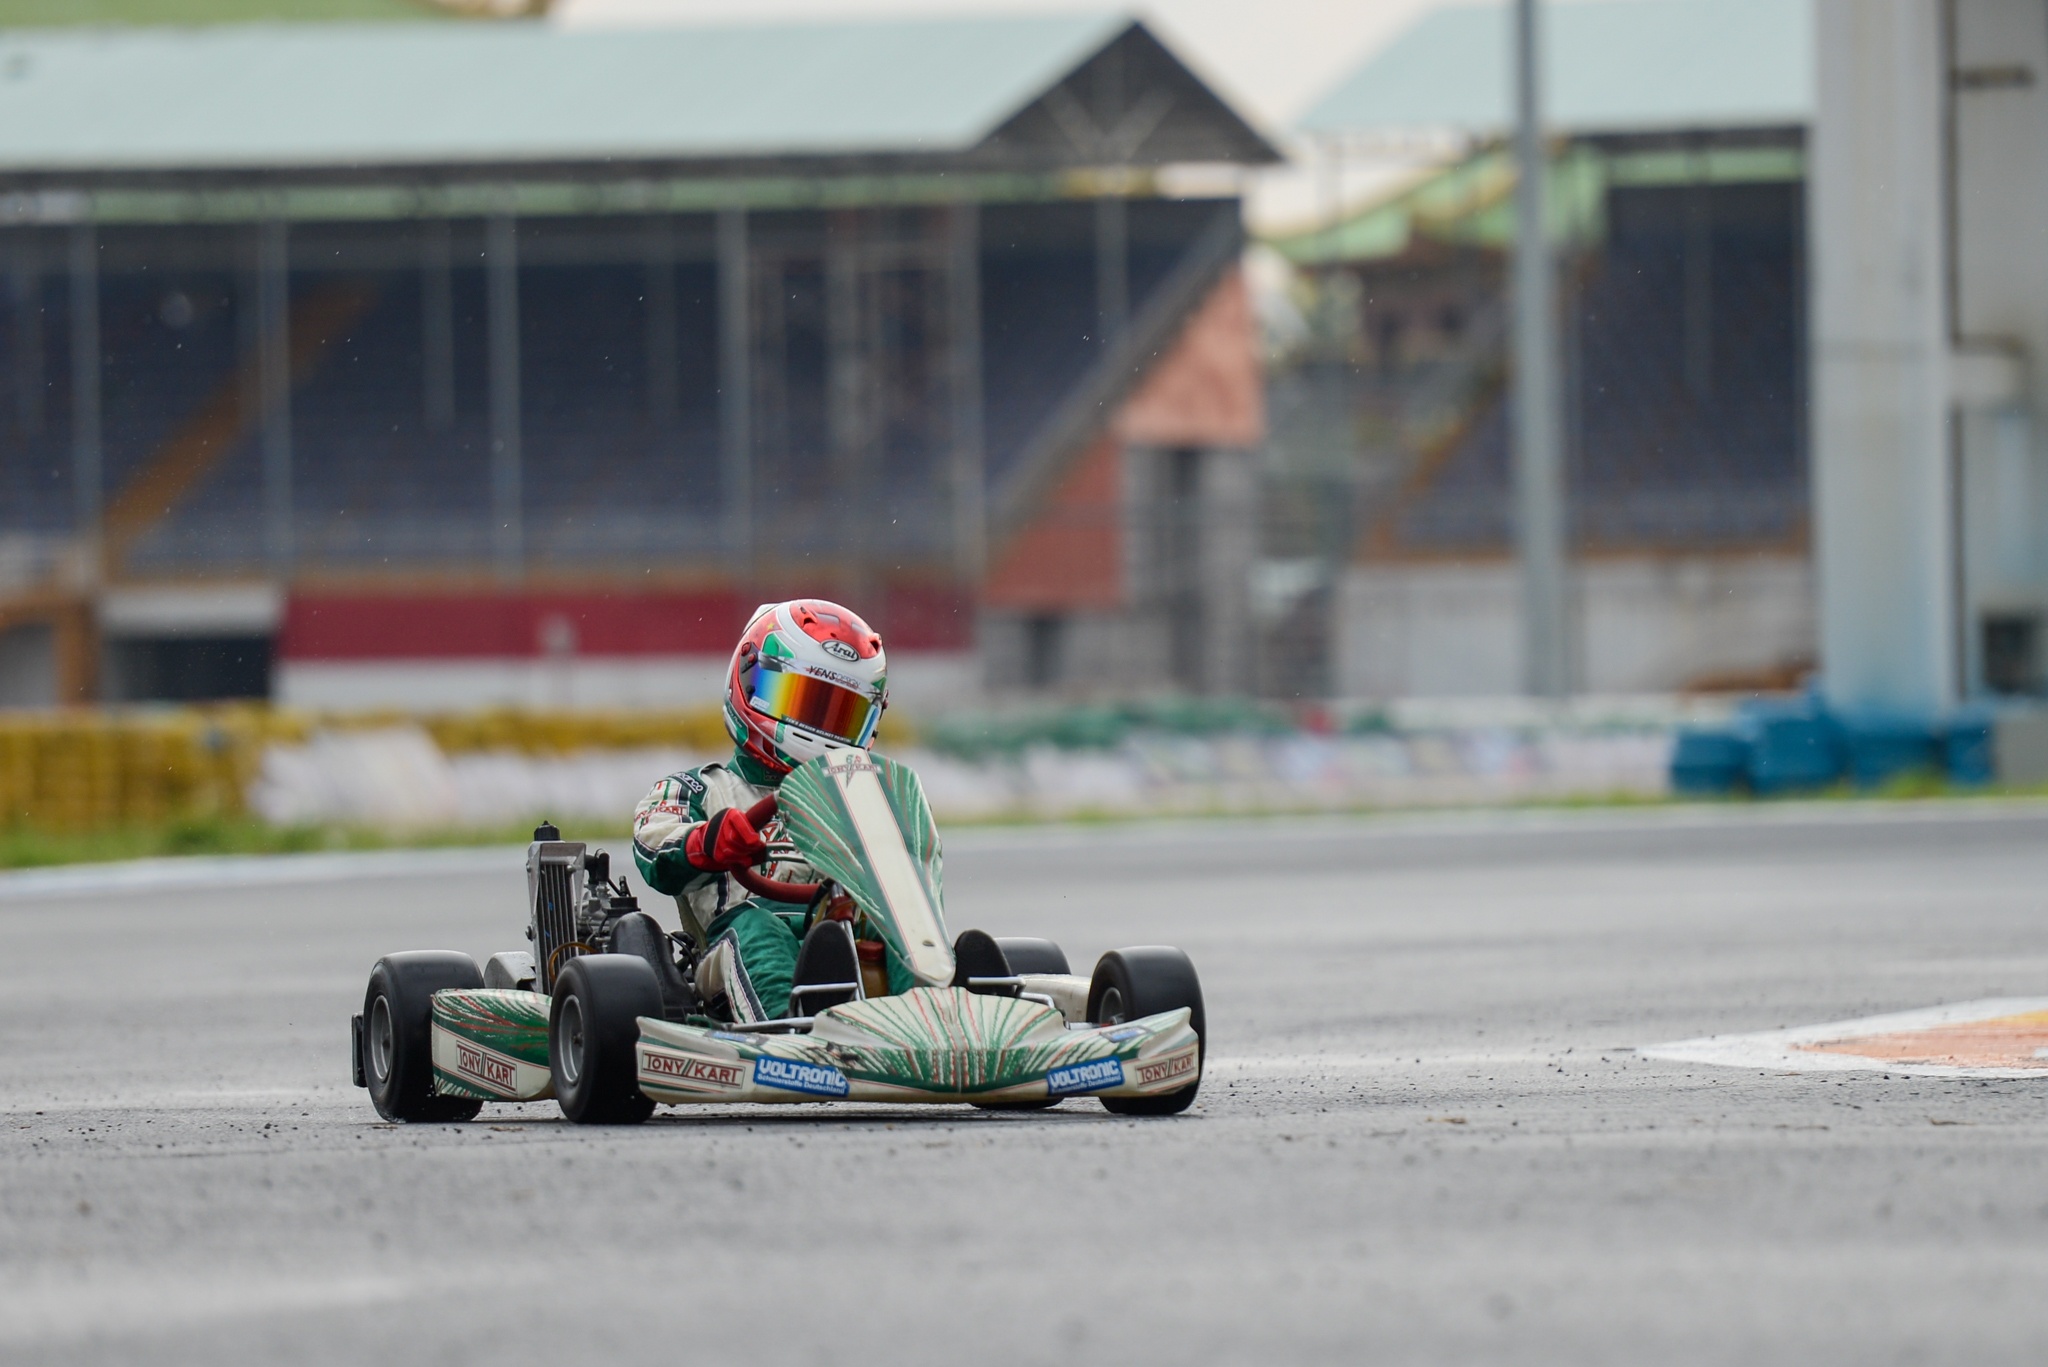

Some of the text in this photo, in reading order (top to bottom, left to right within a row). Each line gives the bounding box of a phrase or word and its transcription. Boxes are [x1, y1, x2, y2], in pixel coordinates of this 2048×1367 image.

[827, 642, 856, 659] Arai
[673, 772, 704, 793] parco
[457, 1044, 516, 1087] TONY KART
[645, 1053, 743, 1084] TONY KART
[759, 1059, 847, 1088] VOLTRONIC
[1049, 1060, 1120, 1089] VOLTRONIC
[1137, 1061, 1168, 1083] TONY
[804, 1081, 845, 1095] Deutschland
